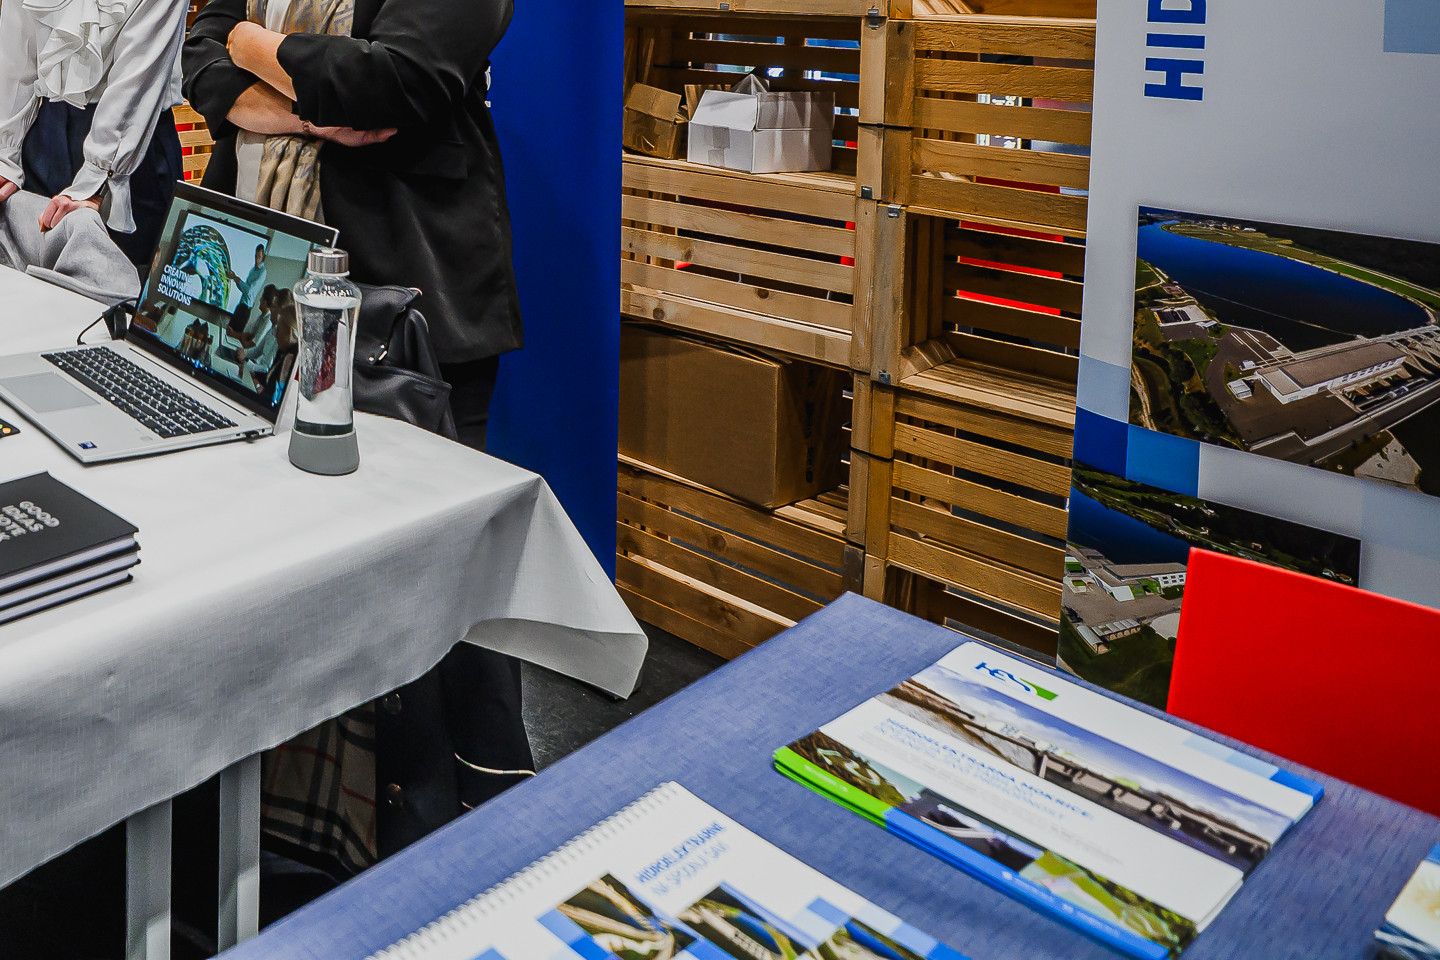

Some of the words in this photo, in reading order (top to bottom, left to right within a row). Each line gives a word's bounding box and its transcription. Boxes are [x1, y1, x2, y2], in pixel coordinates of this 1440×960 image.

[157, 283, 192, 305] SOLUTIONS
[2, 505, 44, 532] IDEAS
[19, 500, 60, 527] GOOD
